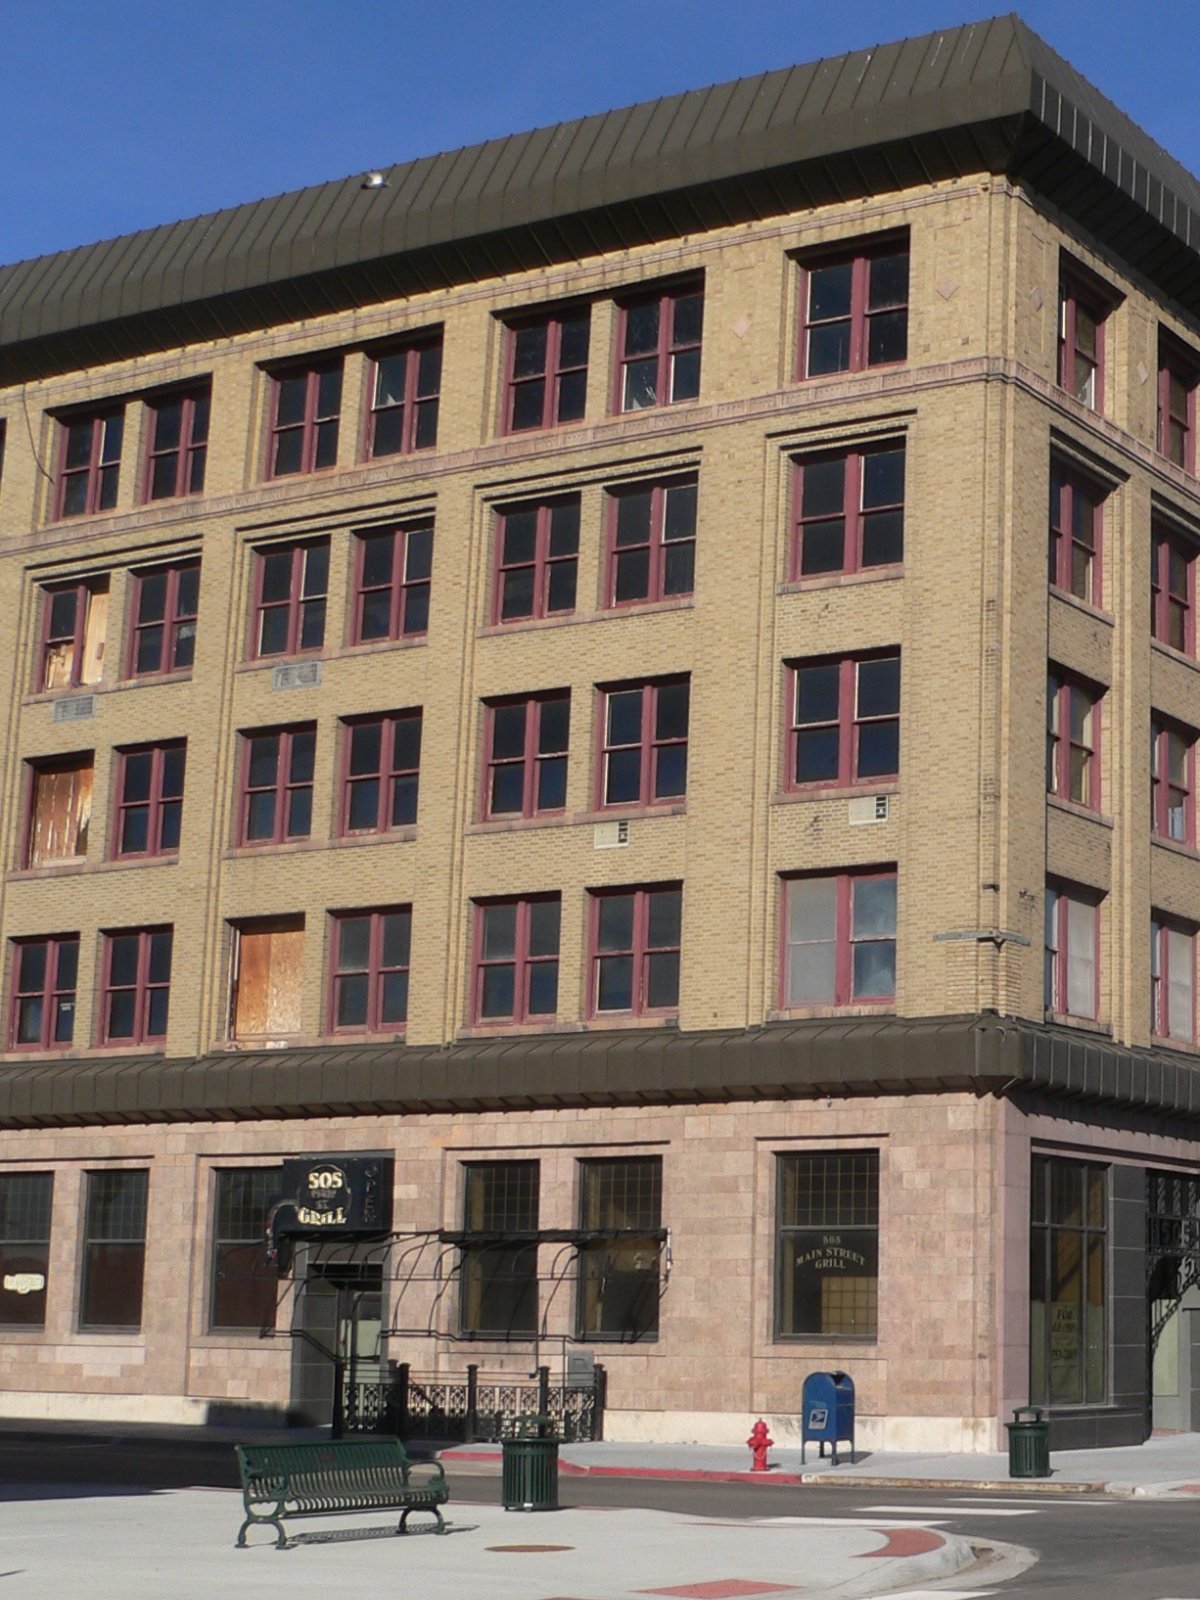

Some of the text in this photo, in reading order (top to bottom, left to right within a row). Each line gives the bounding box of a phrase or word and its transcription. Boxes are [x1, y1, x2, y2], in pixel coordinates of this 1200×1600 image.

[797, 1247, 866, 1266] MAIN STREET
[815, 1258, 846, 1269] GRILL
